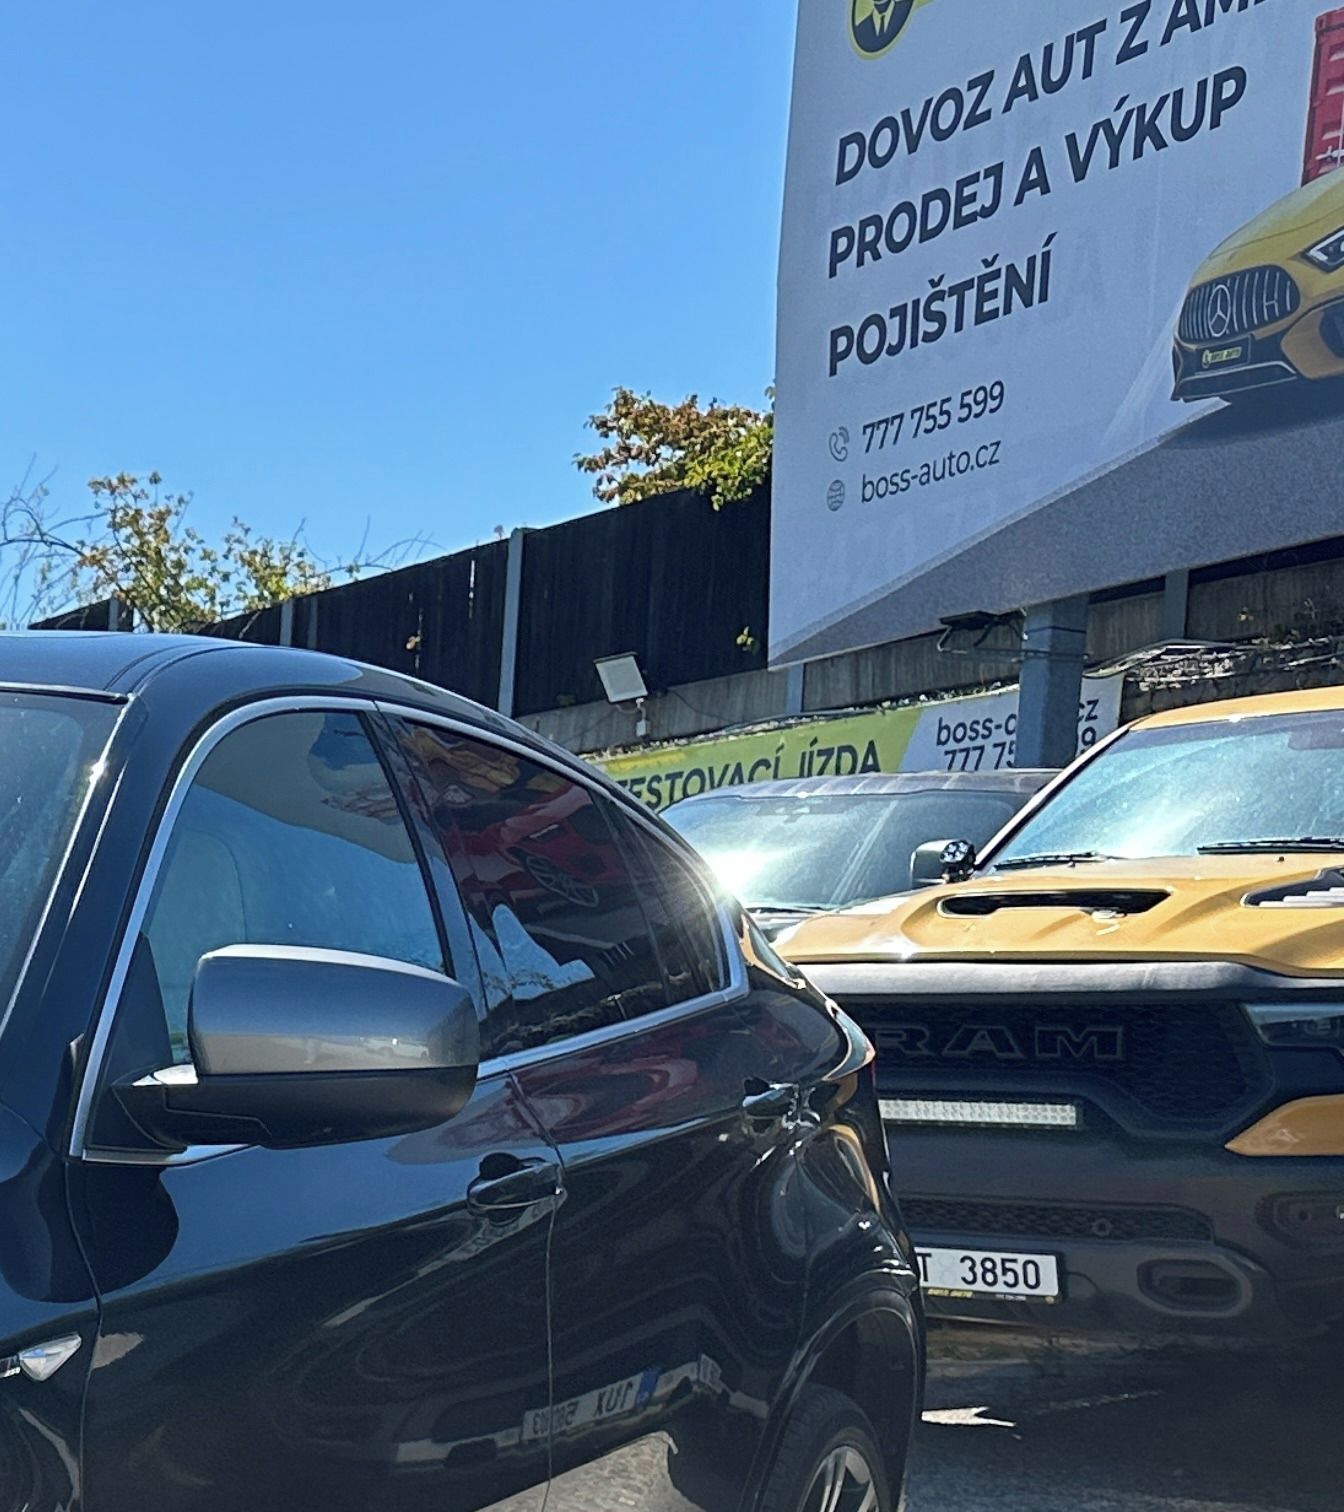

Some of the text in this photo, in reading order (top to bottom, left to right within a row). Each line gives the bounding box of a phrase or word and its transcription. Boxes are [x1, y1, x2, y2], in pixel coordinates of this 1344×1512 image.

[835, 70, 995, 186] DOVOZ
[1002, 18, 1107, 114] AUT
[1115, 0, 1151, 66] Z
[828, 65, 1247, 279] PRODEJ A VÝKUP
[828, 231, 1058, 377] POJIŠTĚNÍ
[862, 380, 1005, 454] 777 755 599
[860, 438, 1003, 504] boss-auto.cz
[944, 745, 985, 771] 777
[862, 1024, 1124, 1059] RAM
[959, 1255, 1041, 1290] 3850
